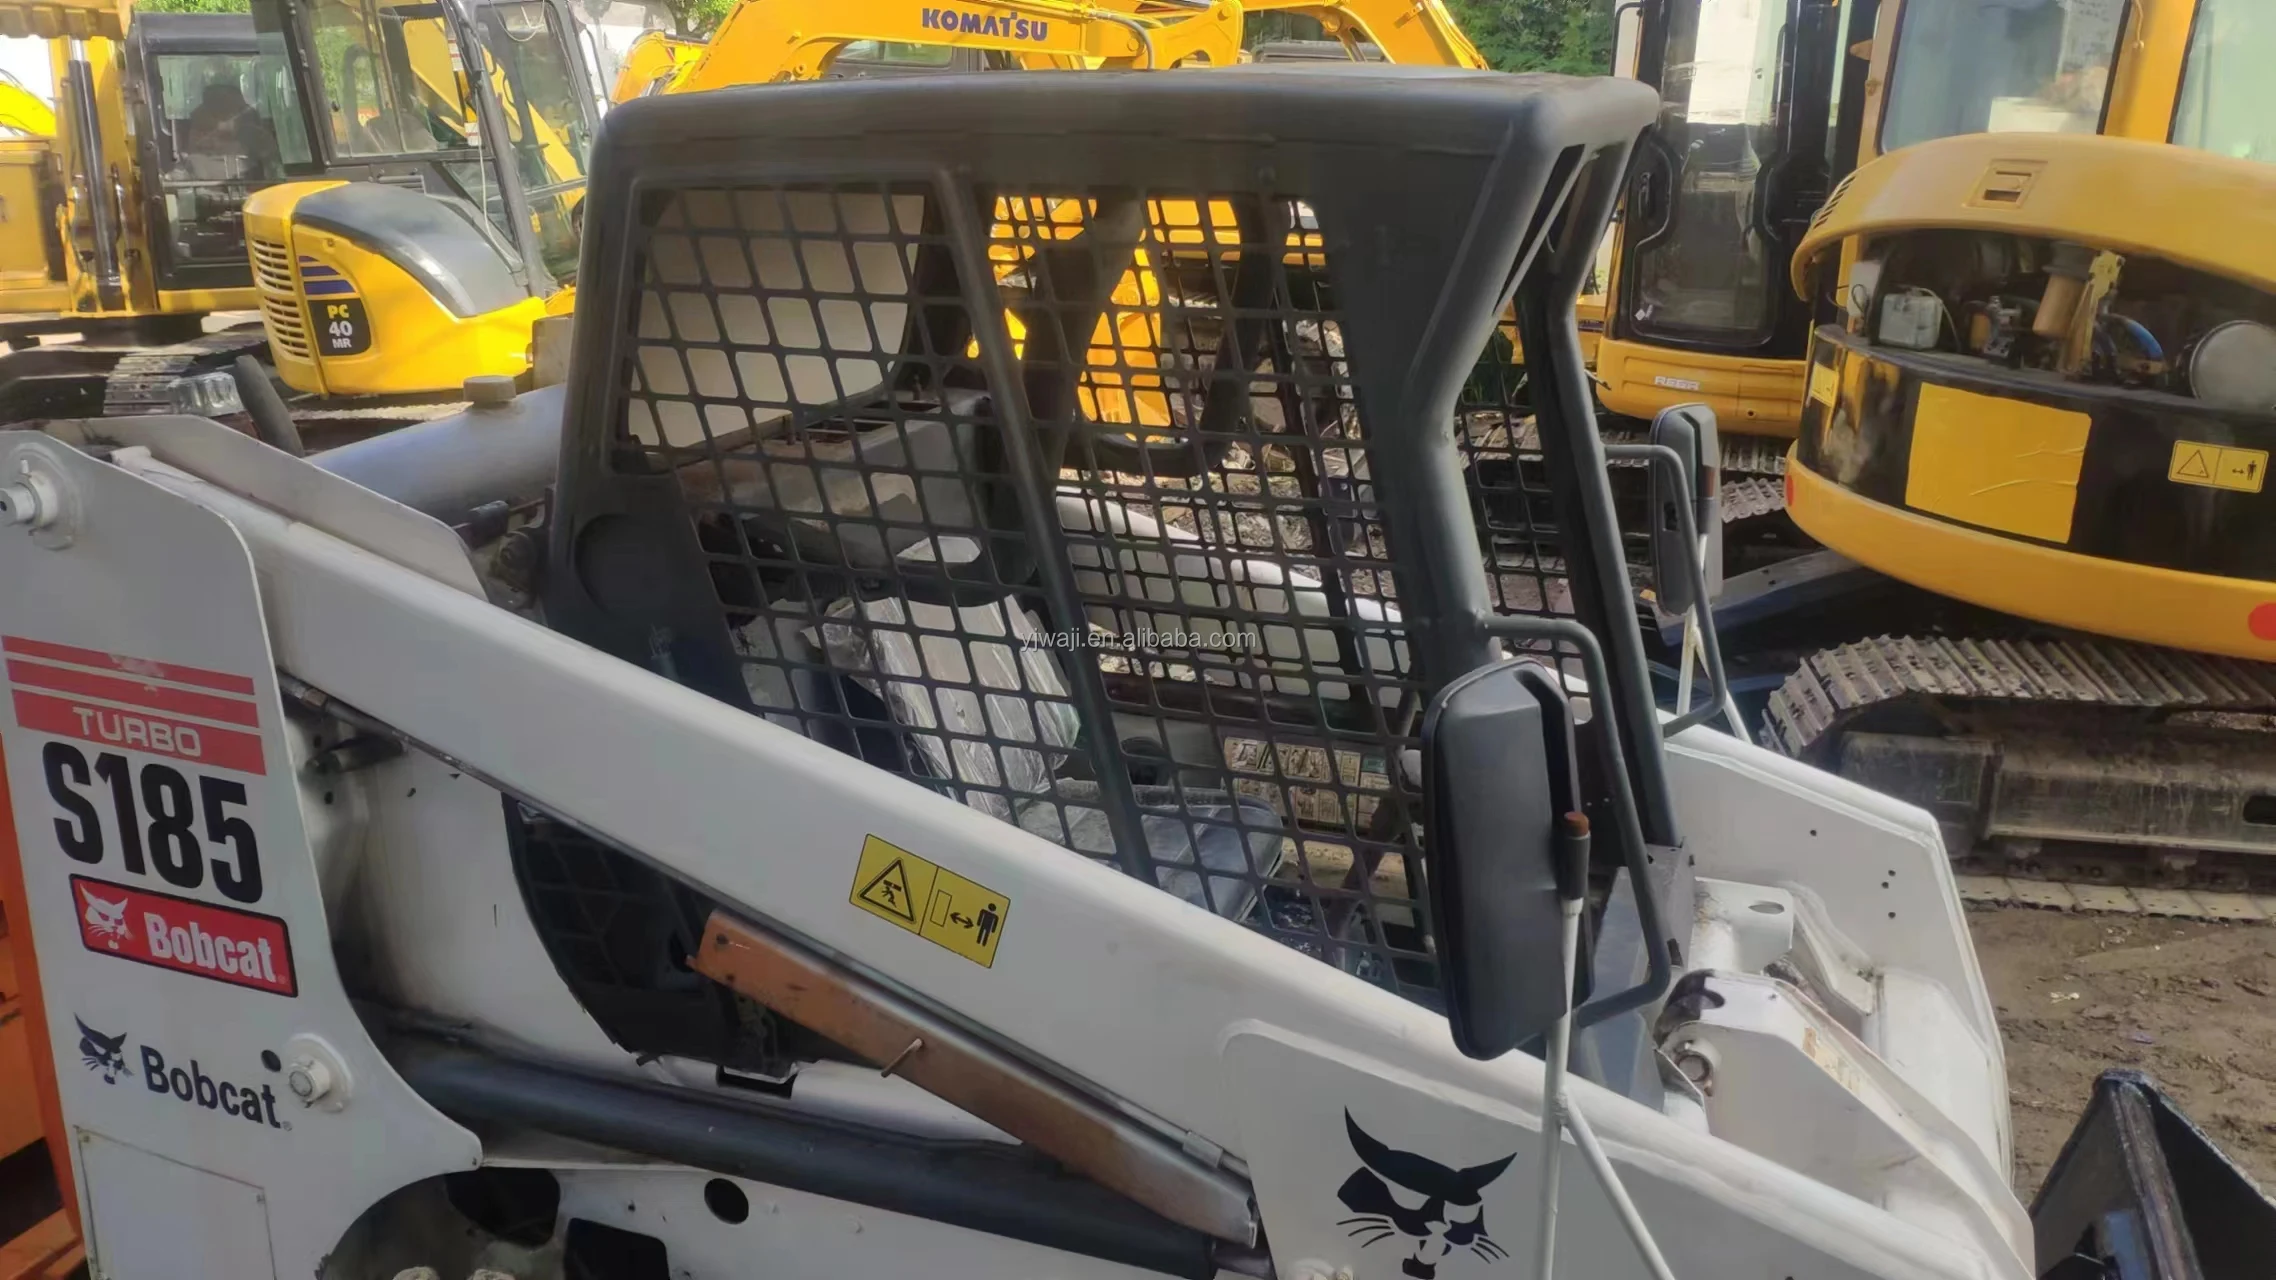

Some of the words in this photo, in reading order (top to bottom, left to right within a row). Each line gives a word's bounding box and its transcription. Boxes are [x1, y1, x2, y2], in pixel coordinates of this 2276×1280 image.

[922, 8, 1048, 41] KOMATSU
[327, 304, 350, 319] PC
[329, 320, 353, 337] 40
[332, 338, 352, 349] MR
[72, 706, 202, 758] TURBO
[42, 741, 263, 904] S185
[143, 911, 277, 983] Bobcat
[140, 1044, 282, 1129] Bobcat
